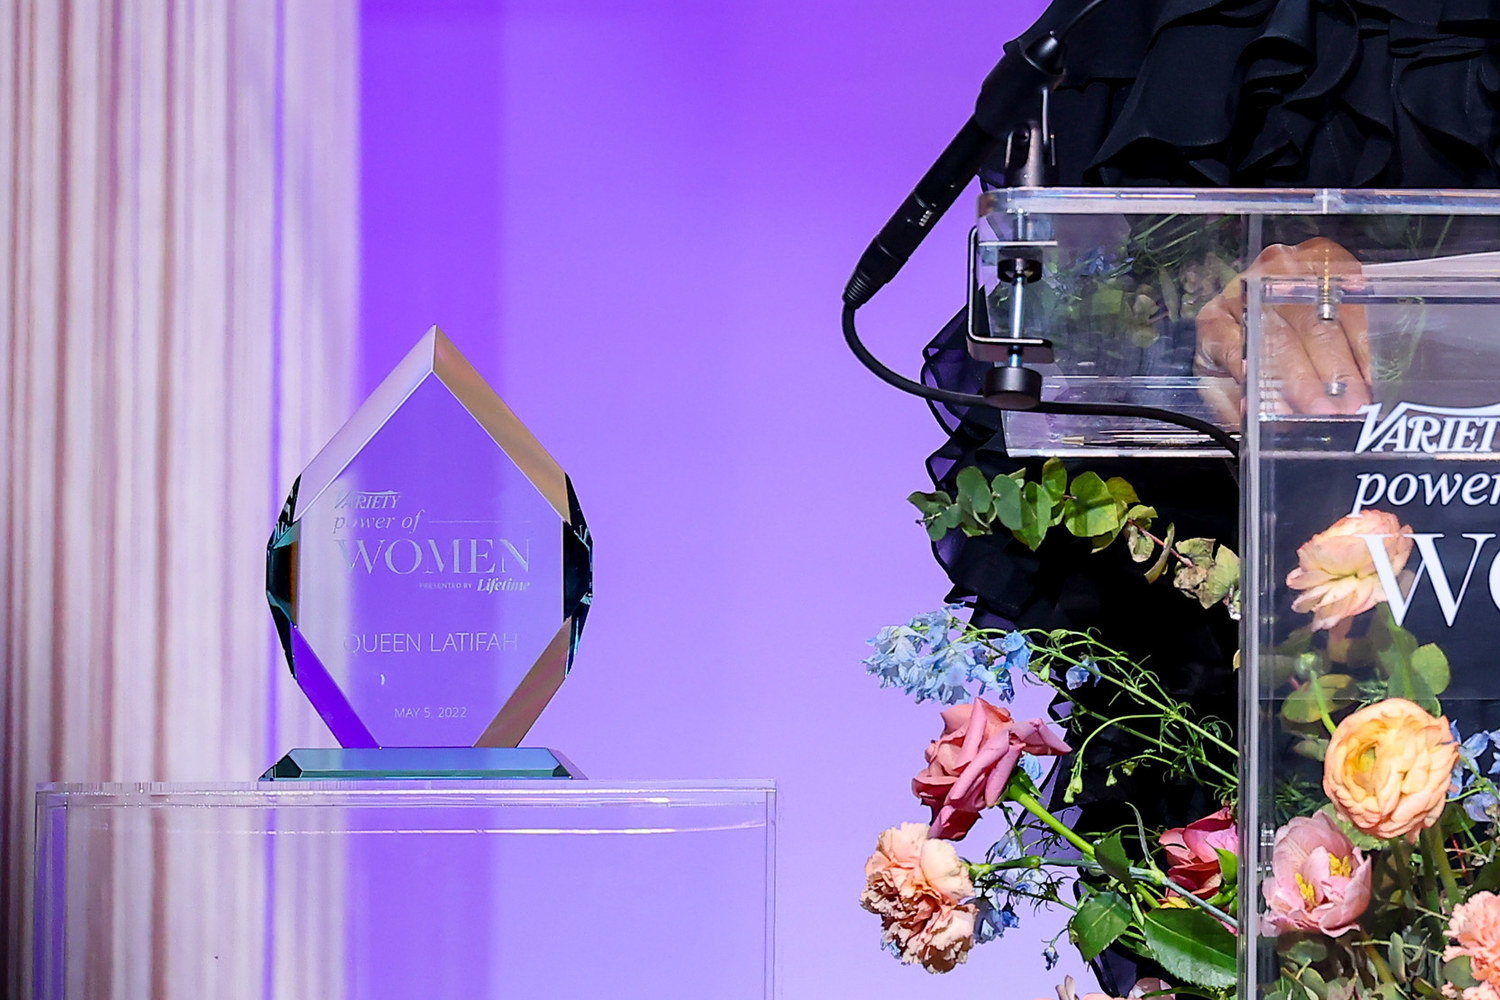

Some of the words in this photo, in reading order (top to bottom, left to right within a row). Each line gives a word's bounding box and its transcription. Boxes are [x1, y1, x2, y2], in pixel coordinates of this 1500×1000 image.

[401, 509, 425, 534] of
[334, 538, 530, 575] WOMEN
[476, 577, 530, 594] Lifetime
[343, 633, 421, 656] QUEEN
[430, 632, 518, 652] LATIFAH
[394, 707, 420, 718] MAY
[438, 706, 467, 718] 2022
